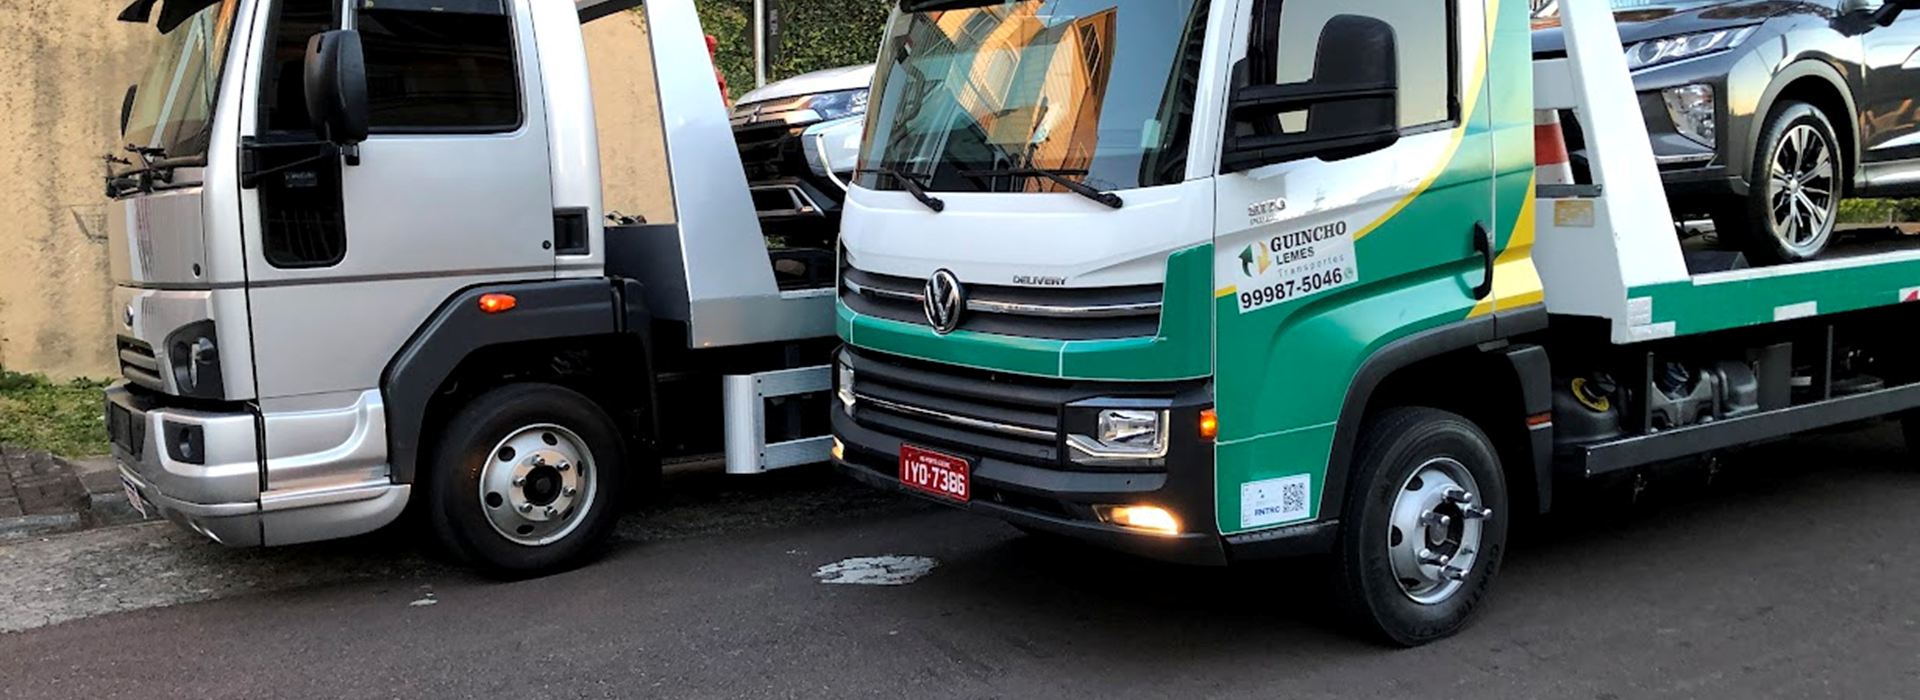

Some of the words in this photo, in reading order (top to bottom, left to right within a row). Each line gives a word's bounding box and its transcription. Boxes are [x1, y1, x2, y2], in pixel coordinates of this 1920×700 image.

[1271, 221, 1346, 252] GUINCHO
[1276, 246, 1315, 265] LEMES
[1278, 254, 1345, 277] Transportes
[1012, 275, 1068, 285] DELIVERY
[1241, 267, 1343, 309] 99987-5046
